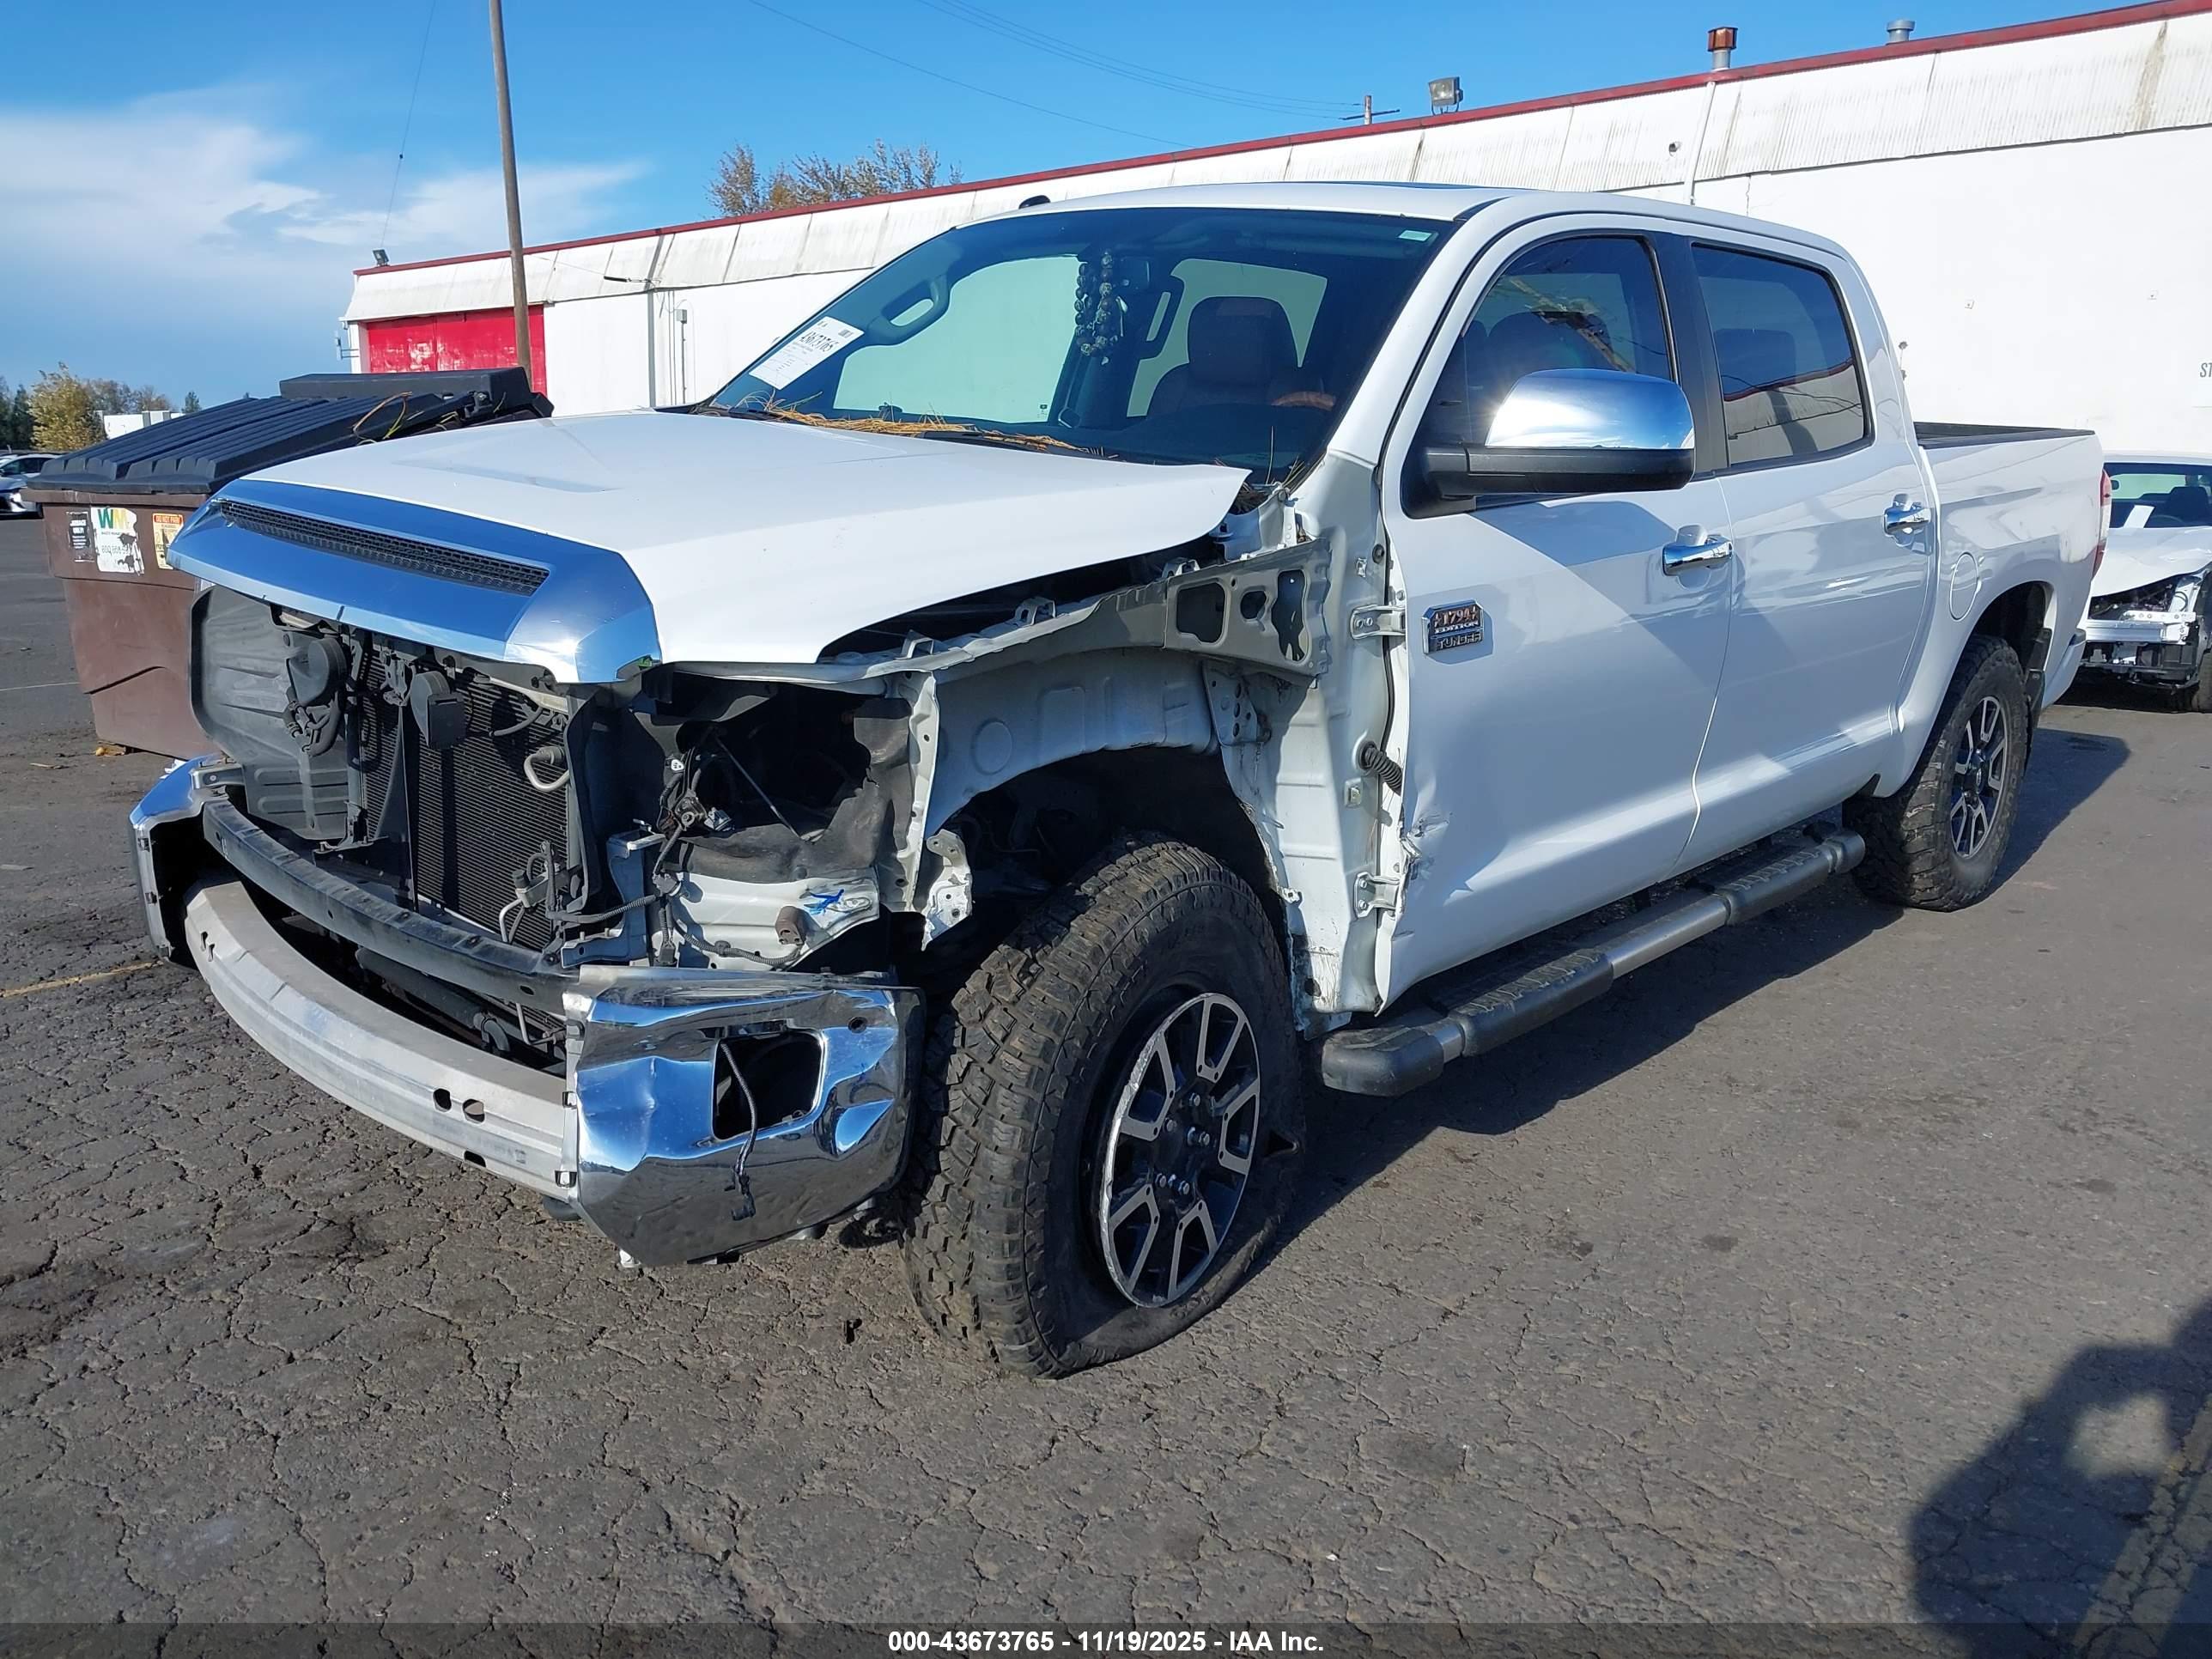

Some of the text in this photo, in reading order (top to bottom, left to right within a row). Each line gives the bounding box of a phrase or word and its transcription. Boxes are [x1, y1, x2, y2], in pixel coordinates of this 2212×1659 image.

[1443, 607, 1471, 625] 1794
[1434, 620, 1479, 634] EDITION
[1438, 632, 1481, 649] TUNDRA
